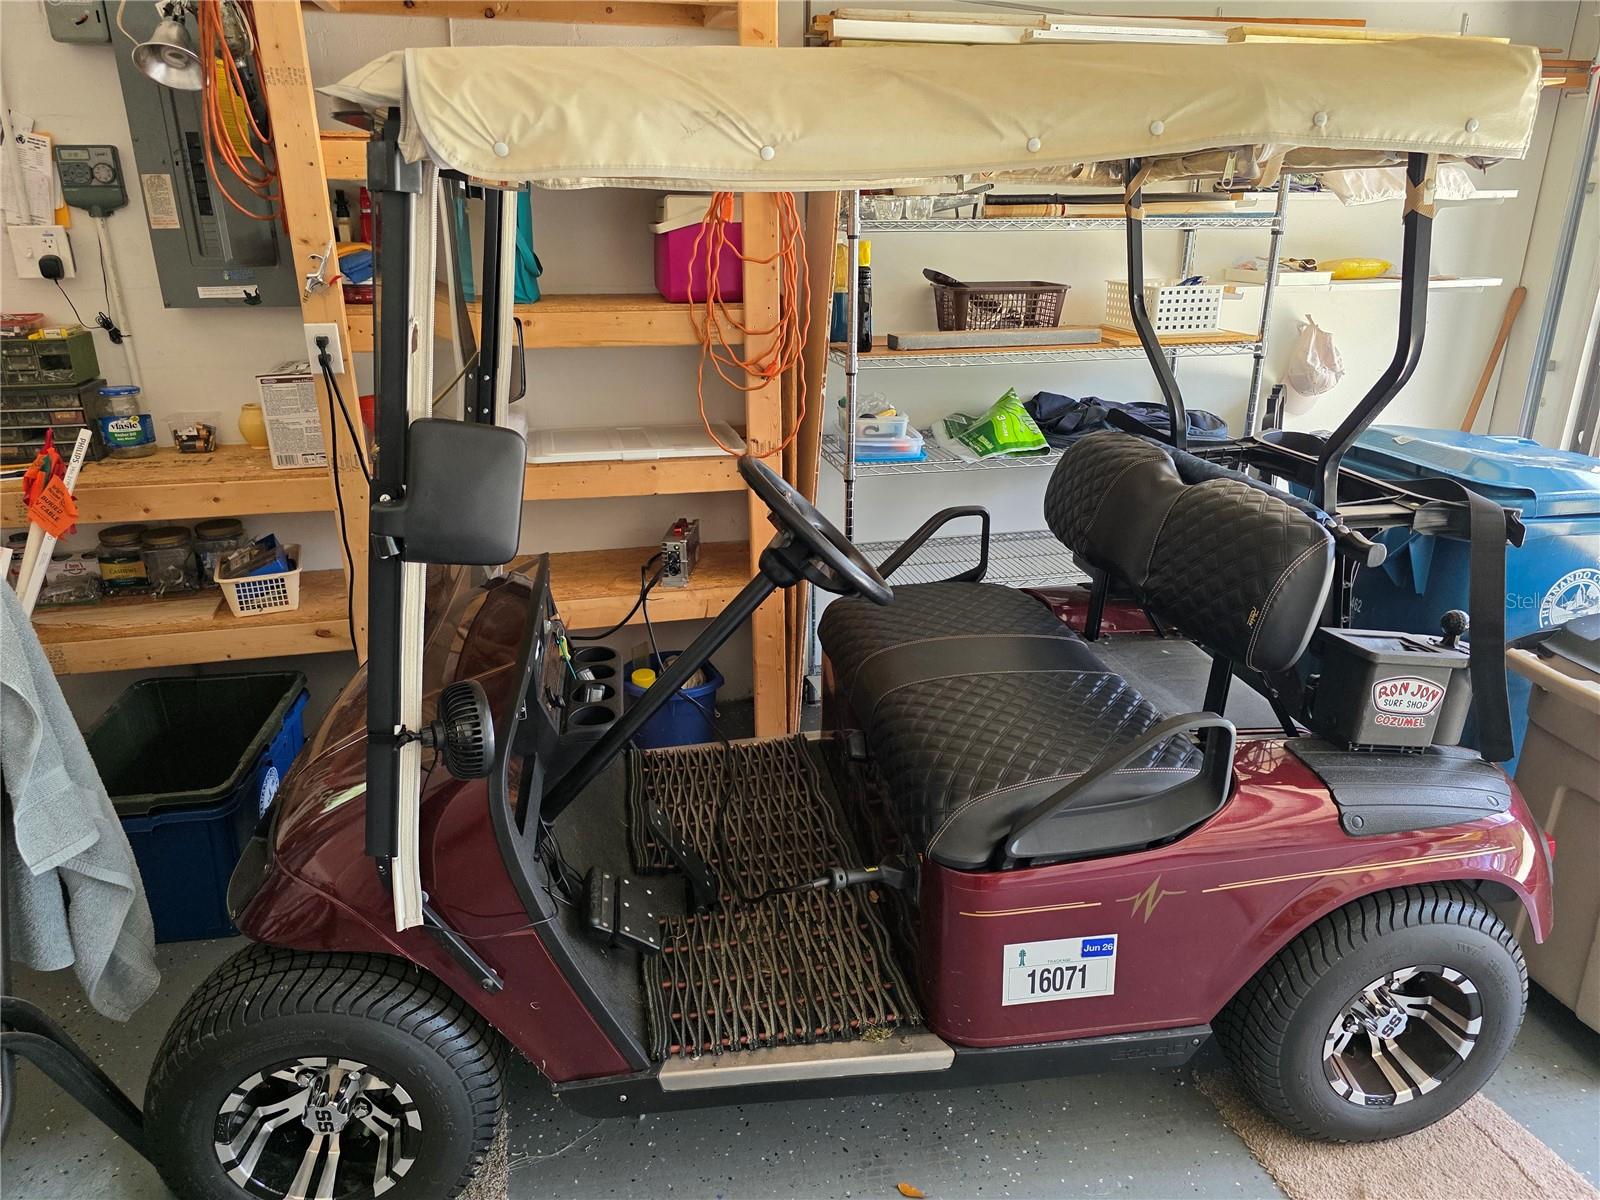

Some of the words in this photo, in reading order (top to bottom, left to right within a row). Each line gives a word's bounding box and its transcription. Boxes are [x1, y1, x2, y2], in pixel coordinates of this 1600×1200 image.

[40, 495, 63, 514] BURIED
[40, 505, 60, 522] CABLE
[1541, 571, 1591, 617] HERNANDO
[1378, 682, 1410, 699] RON
[1410, 684, 1439, 702] JON
[1383, 699, 1403, 707] SURF
[1406, 700, 1428, 709] SHOP
[1375, 714, 1425, 728] COZUMEL
[1083, 944, 1100, 952] Jun
[1102, 943, 1113, 951] 26
[1027, 964, 1087, 994] 16071
[1381, 1014, 1402, 1037] SS
[315, 1110, 334, 1132] SS
